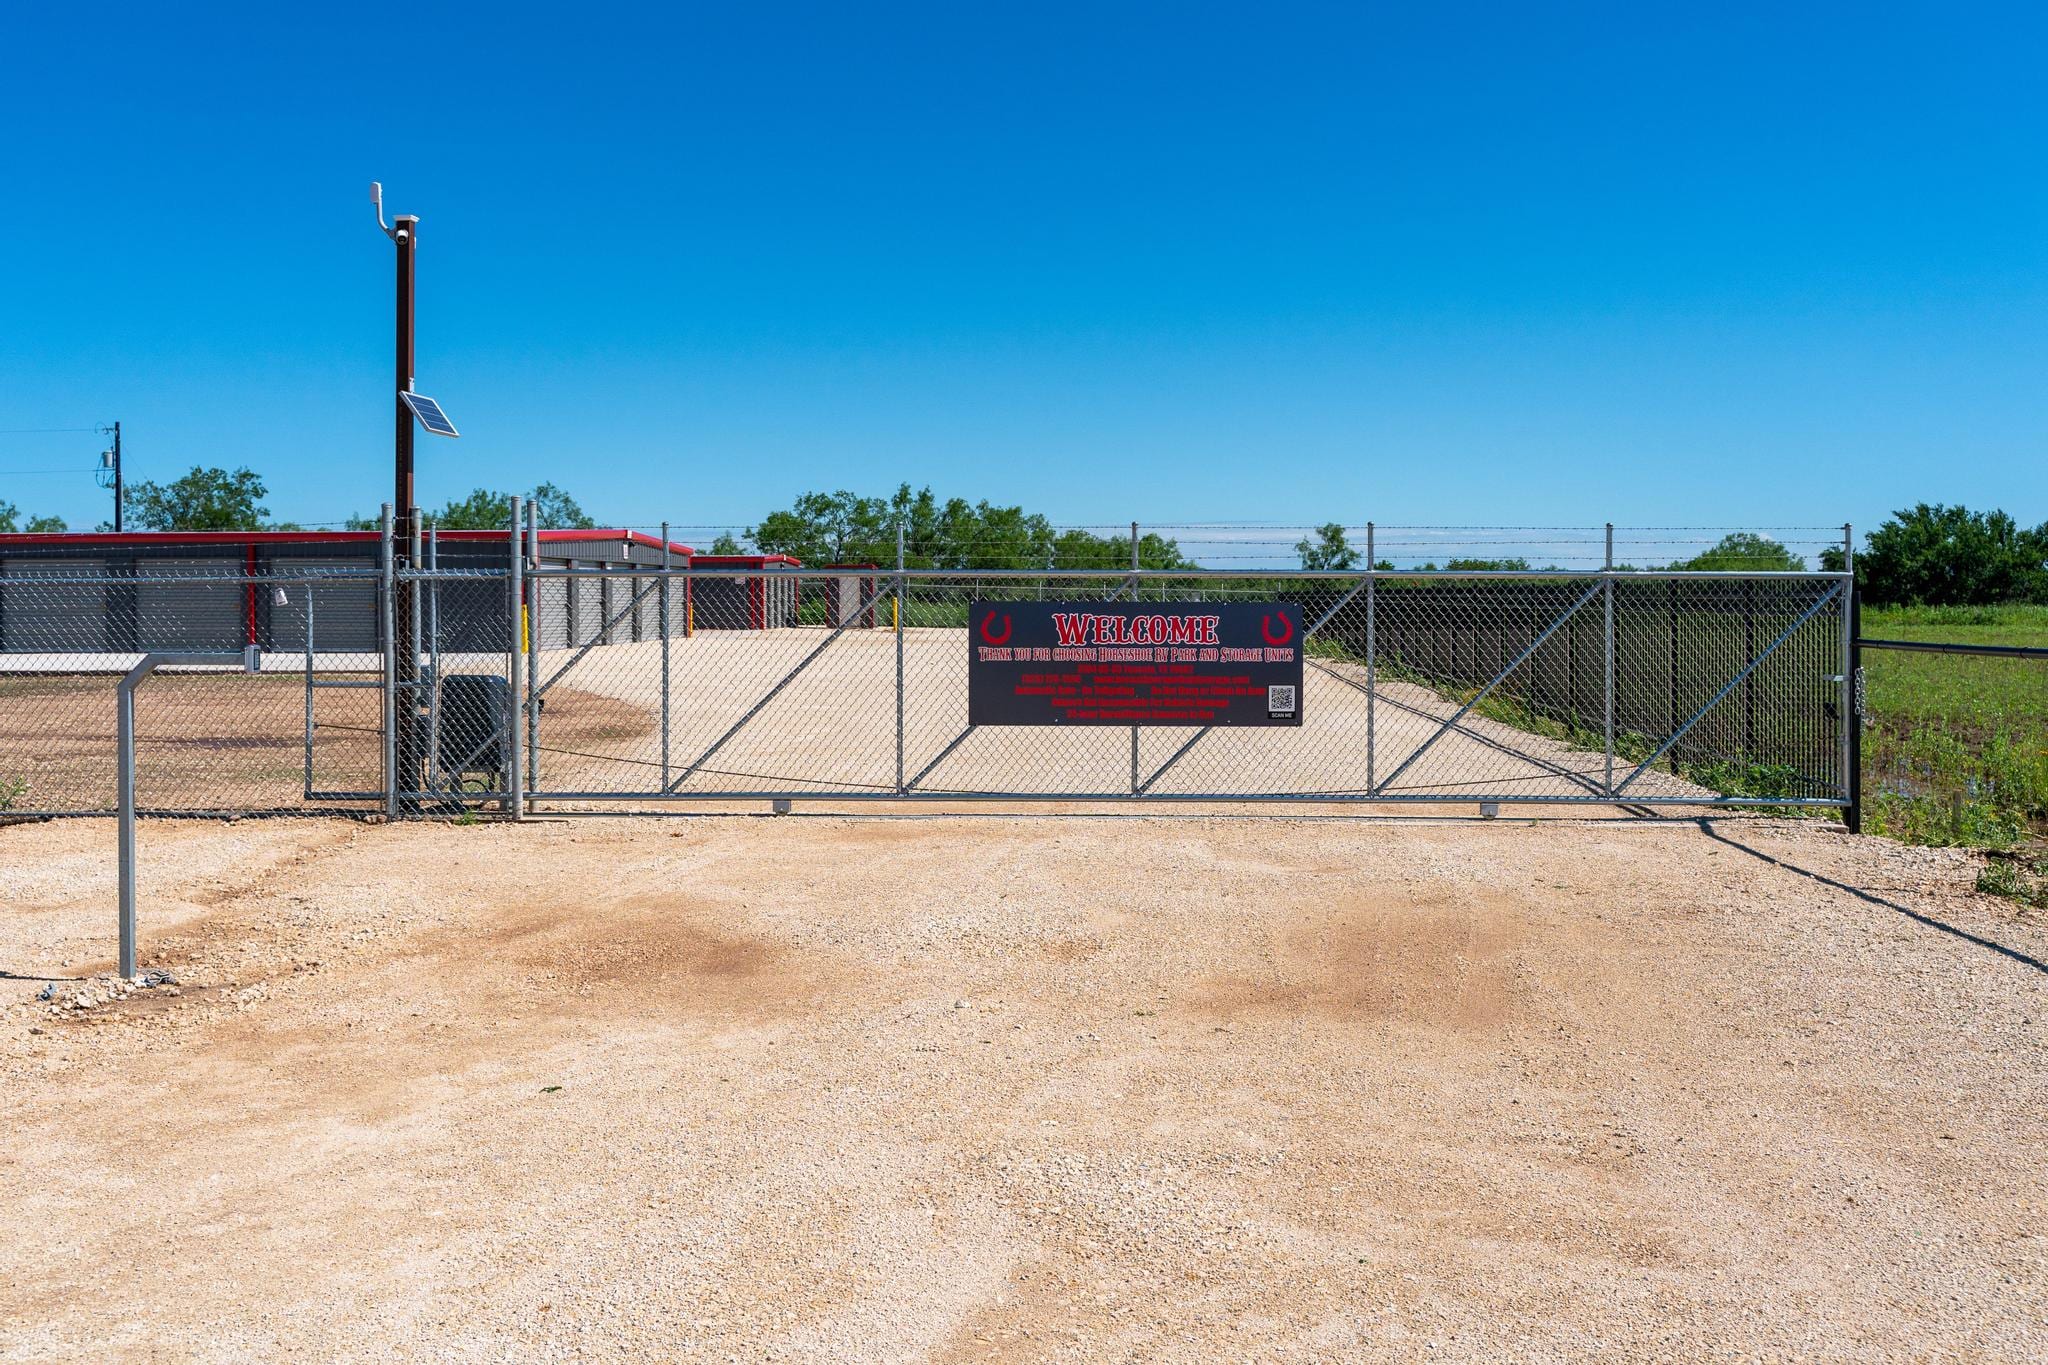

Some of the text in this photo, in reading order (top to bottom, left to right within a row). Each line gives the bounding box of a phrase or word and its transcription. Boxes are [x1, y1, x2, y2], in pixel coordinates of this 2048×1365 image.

[1052, 613, 1219, 646] WELCOME
[978, 646, 1294, 661] THANK YOU FOR CHOOSING HORSESHOE RV PARK AND STORAGE UNITS
